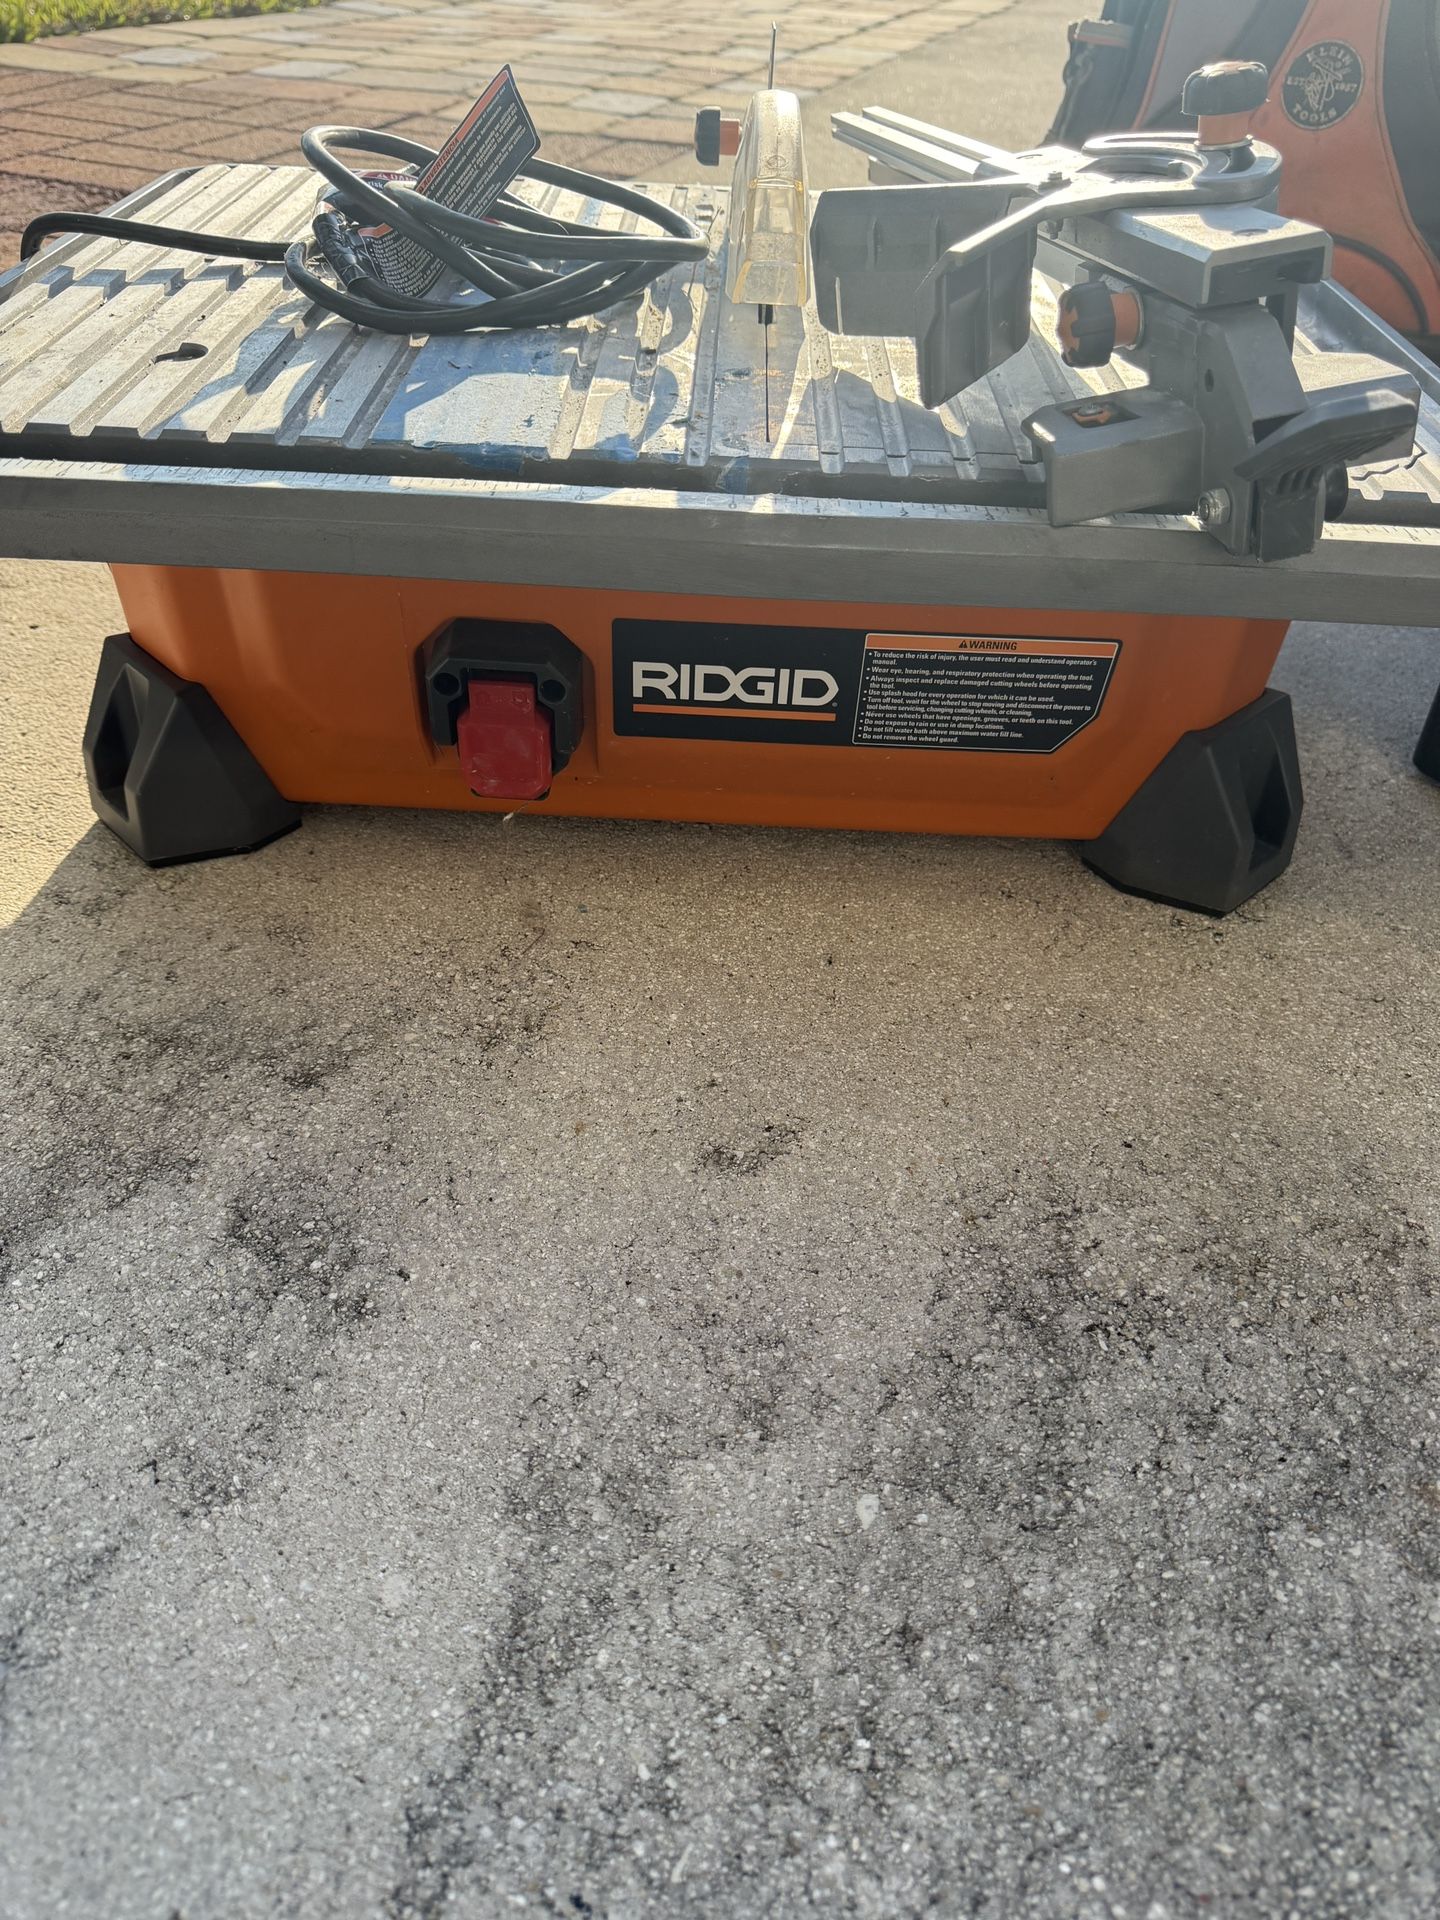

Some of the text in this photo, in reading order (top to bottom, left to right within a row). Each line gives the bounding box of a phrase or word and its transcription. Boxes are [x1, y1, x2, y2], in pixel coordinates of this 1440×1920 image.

[1306, 46, 1354, 66] KLEIN
[1293, 103, 1337, 122] TOOLS
[969, 640, 1017, 650] WARNING
[945, 669, 981, 677] respiratory
[982, 671, 1015, 679] protection
[1035, 673, 1066, 681] operating
[632, 661, 840, 706] RIDGID
[933, 677, 958, 685] replace
[959, 678, 989, 686] damaged
[1060, 682, 1092, 690] operating
[946, 692, 976, 700] operation
